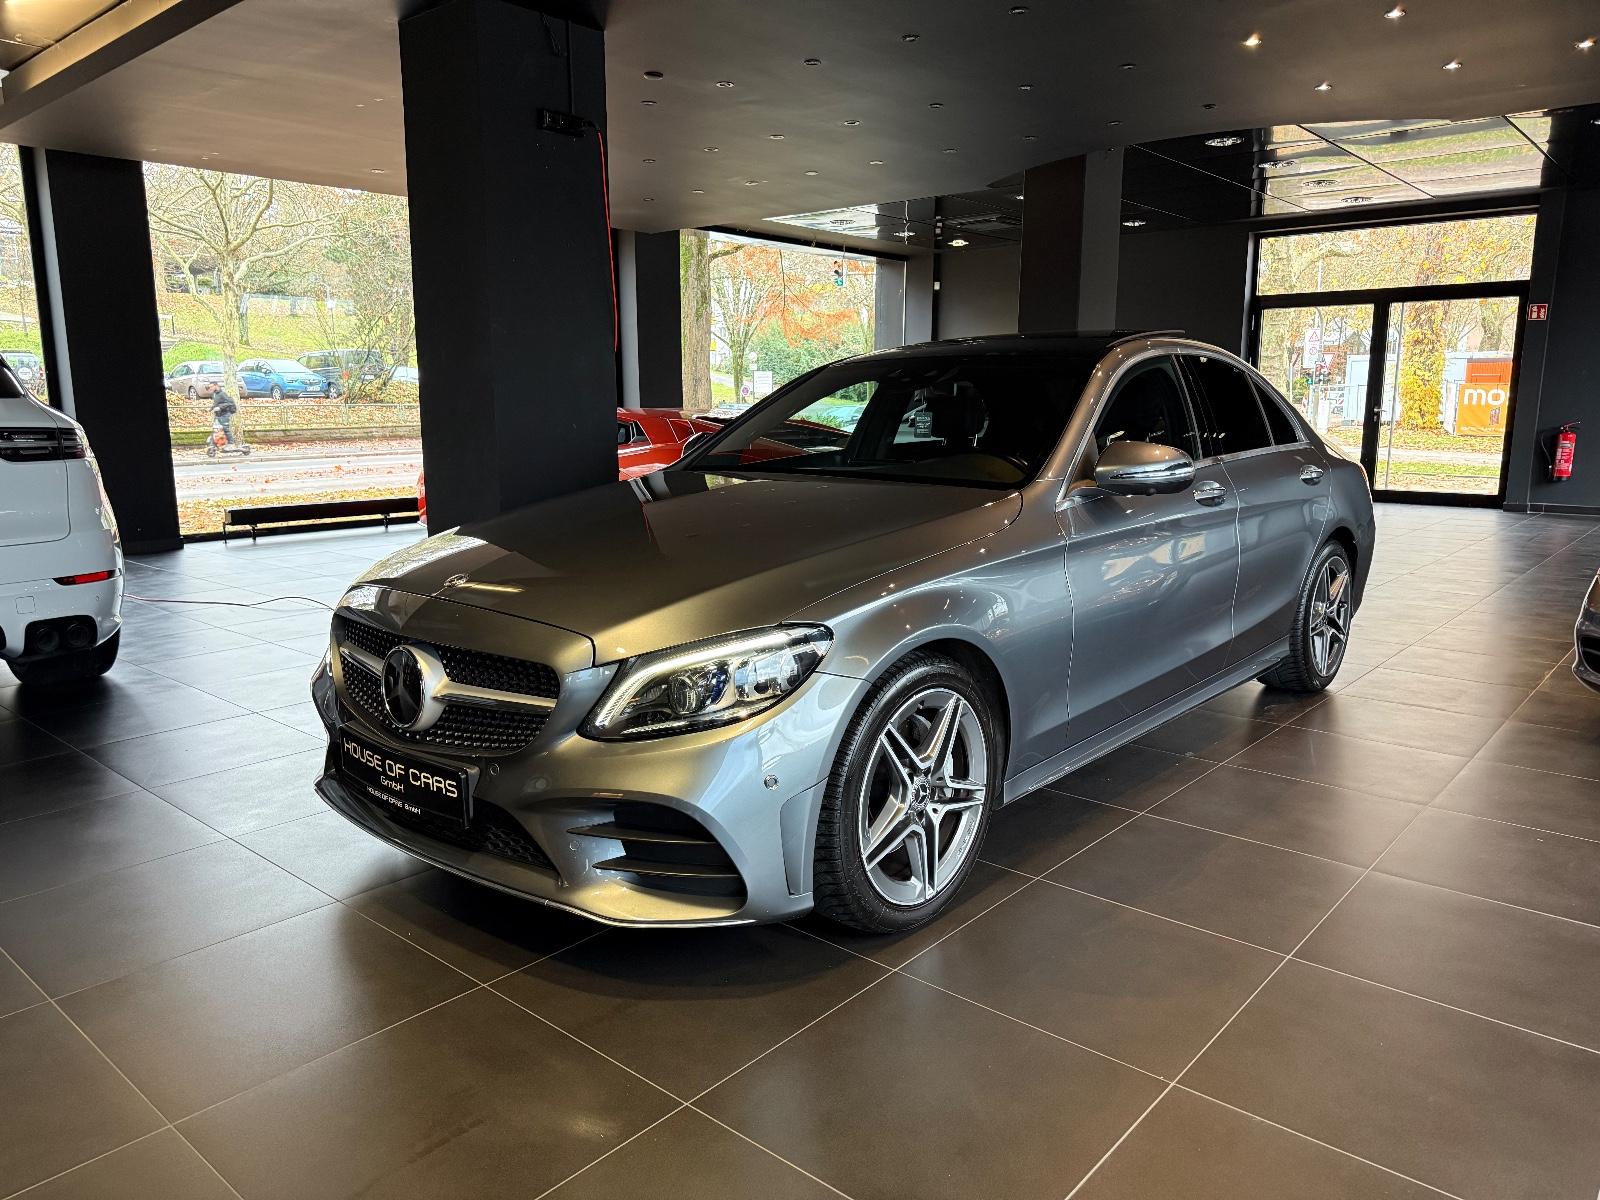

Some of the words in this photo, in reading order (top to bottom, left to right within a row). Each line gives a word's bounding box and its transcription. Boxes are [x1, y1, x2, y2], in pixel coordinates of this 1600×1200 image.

[1463, 388, 1509, 407] mo
[344, 737, 382, 771] HOUSE
[385, 760, 405, 778] OF
[409, 769, 458, 798] CARS
[380, 776, 405, 793] GmbH
